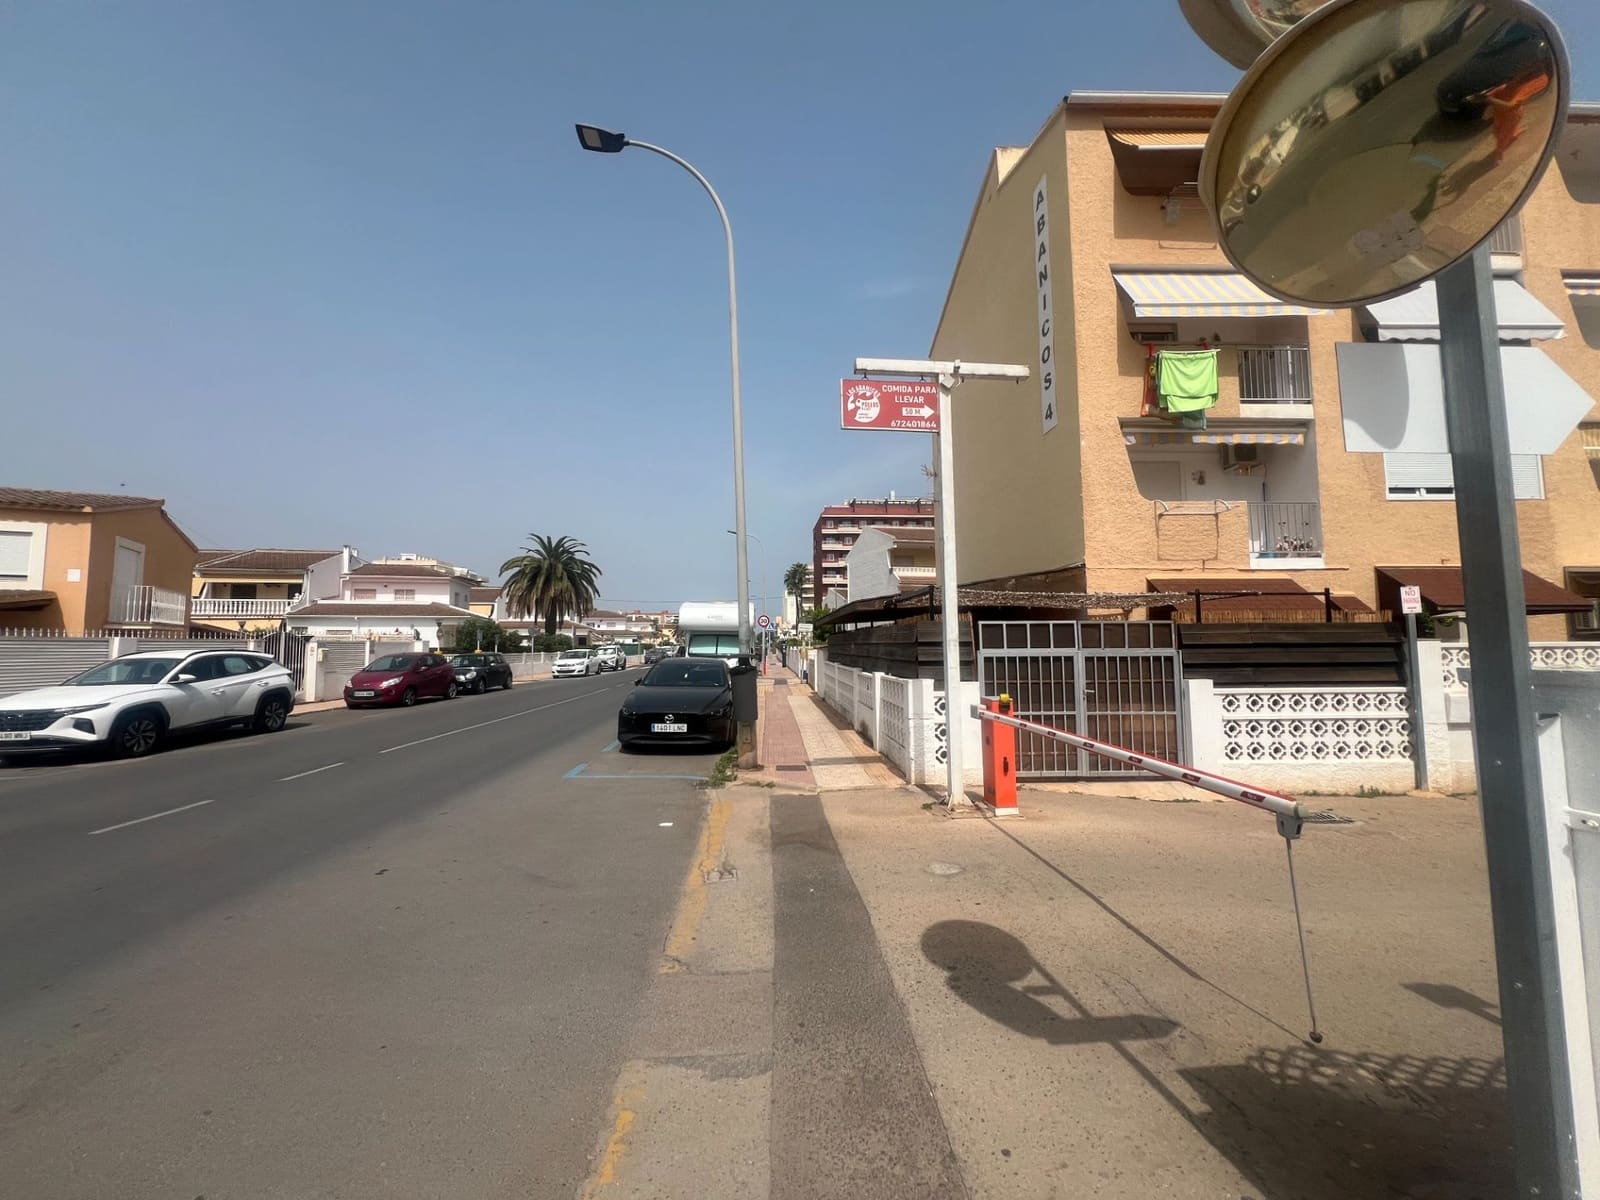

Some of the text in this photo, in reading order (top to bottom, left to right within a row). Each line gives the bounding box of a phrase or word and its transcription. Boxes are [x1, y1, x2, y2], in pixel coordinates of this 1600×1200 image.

[1036, 189, 1053, 420] ABANICOS 4
[882, 384, 937, 394] COMIDA PARA
[894, 395, 925, 404] LLEVAR
[890, 420, 937, 428] 672401864
